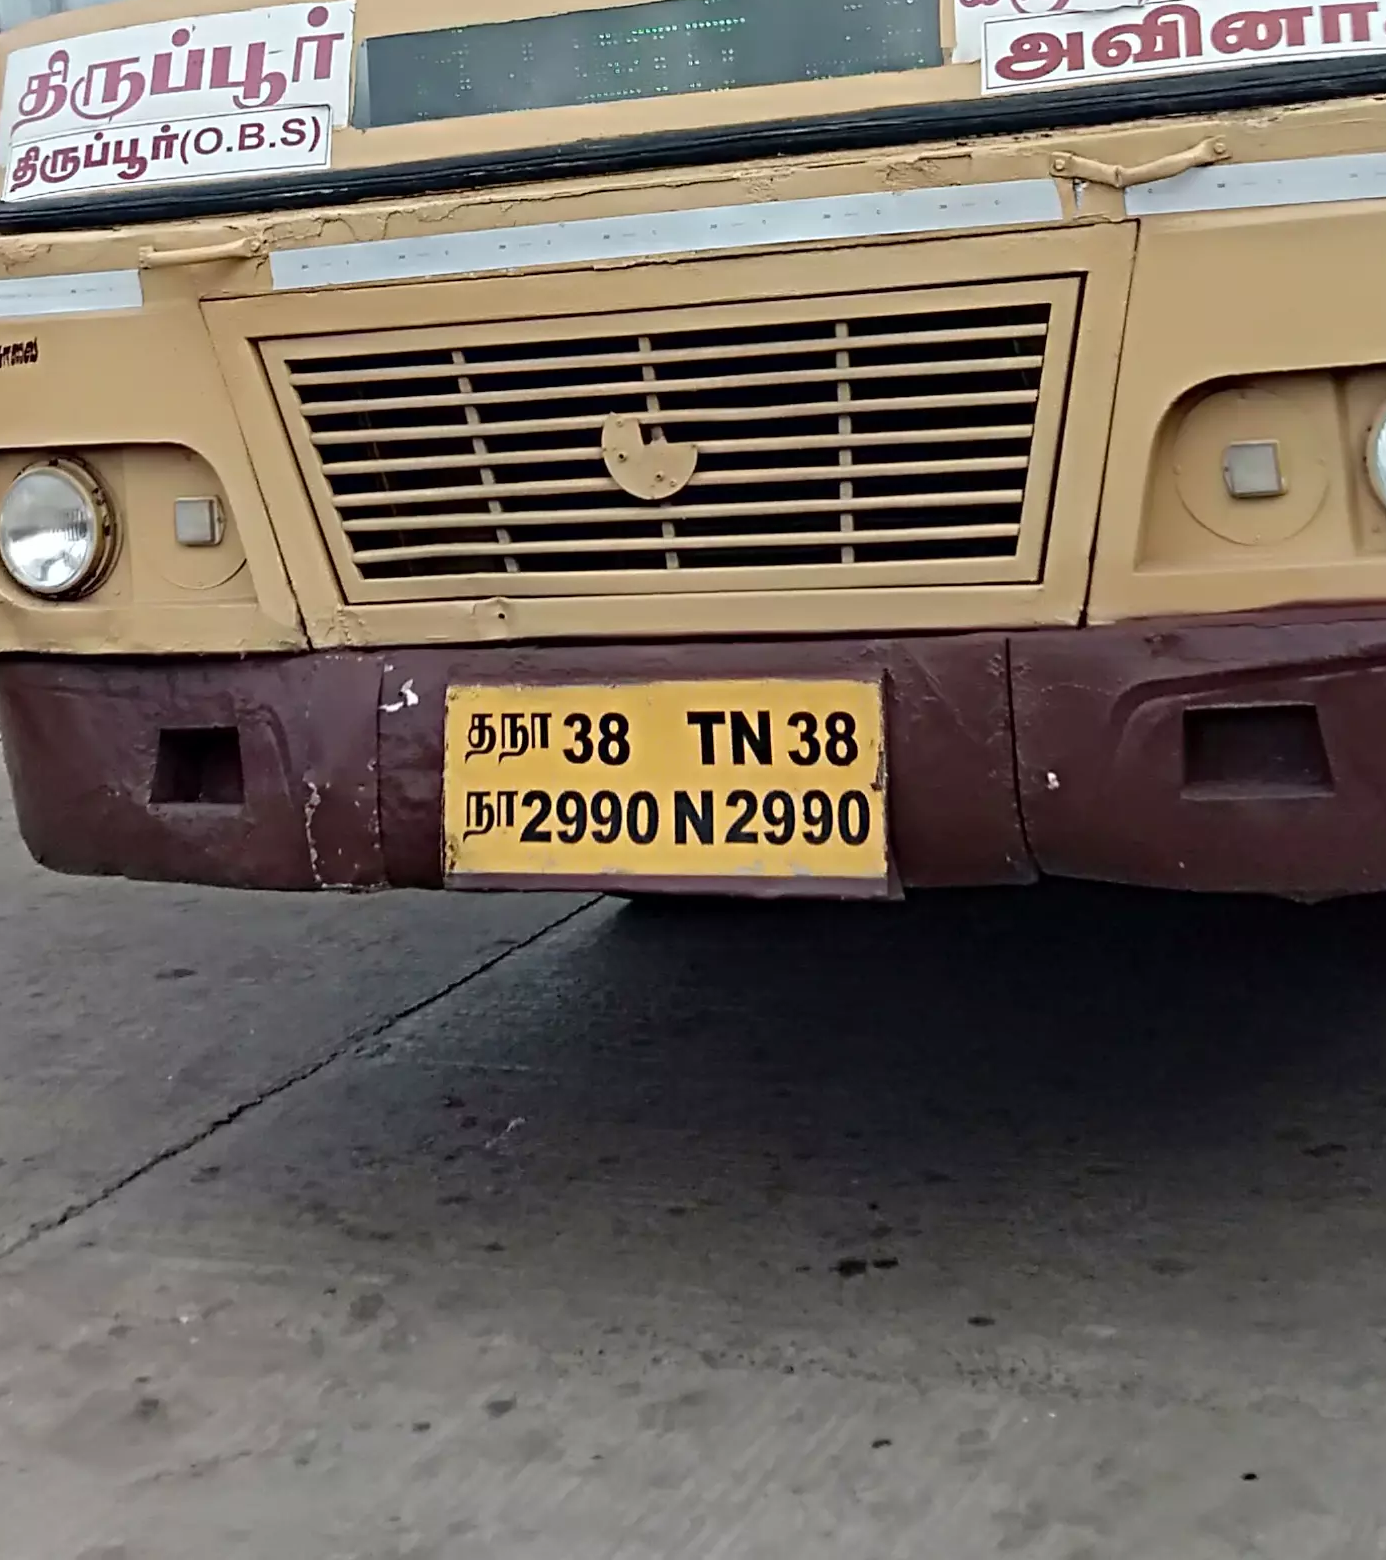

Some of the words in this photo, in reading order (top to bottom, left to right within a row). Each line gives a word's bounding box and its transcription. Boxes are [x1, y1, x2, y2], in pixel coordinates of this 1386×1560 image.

[11, 6, 345, 135] திருப்பூர்
[563, 712, 630, 765] 38
[687, 710, 774, 766] TN
[788, 711, 858, 766] 38
